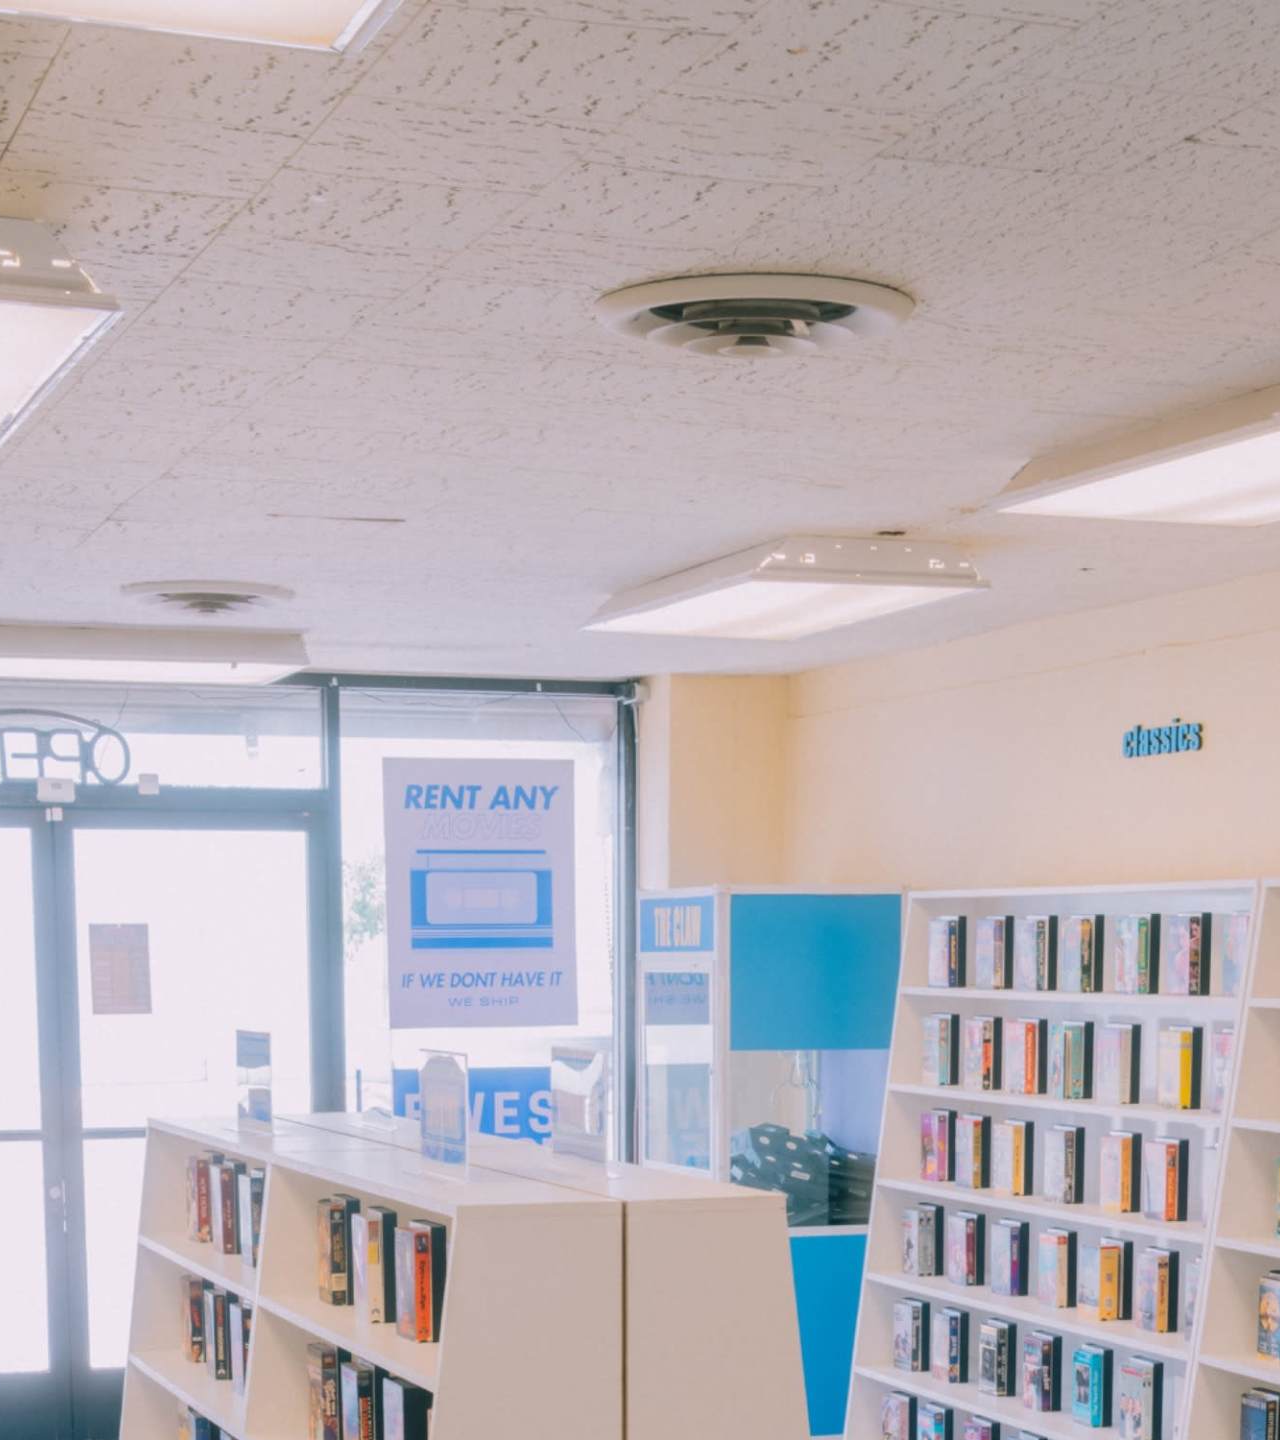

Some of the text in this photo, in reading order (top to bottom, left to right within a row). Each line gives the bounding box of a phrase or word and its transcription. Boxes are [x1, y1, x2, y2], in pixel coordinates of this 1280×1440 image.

[1123, 718, 1203, 758] classics
[404, 785, 559, 810] RENT ANY
[402, 971, 562, 988] IF WE DONT HAVE IT
[447, 996, 520, 1008] WE SHIP
